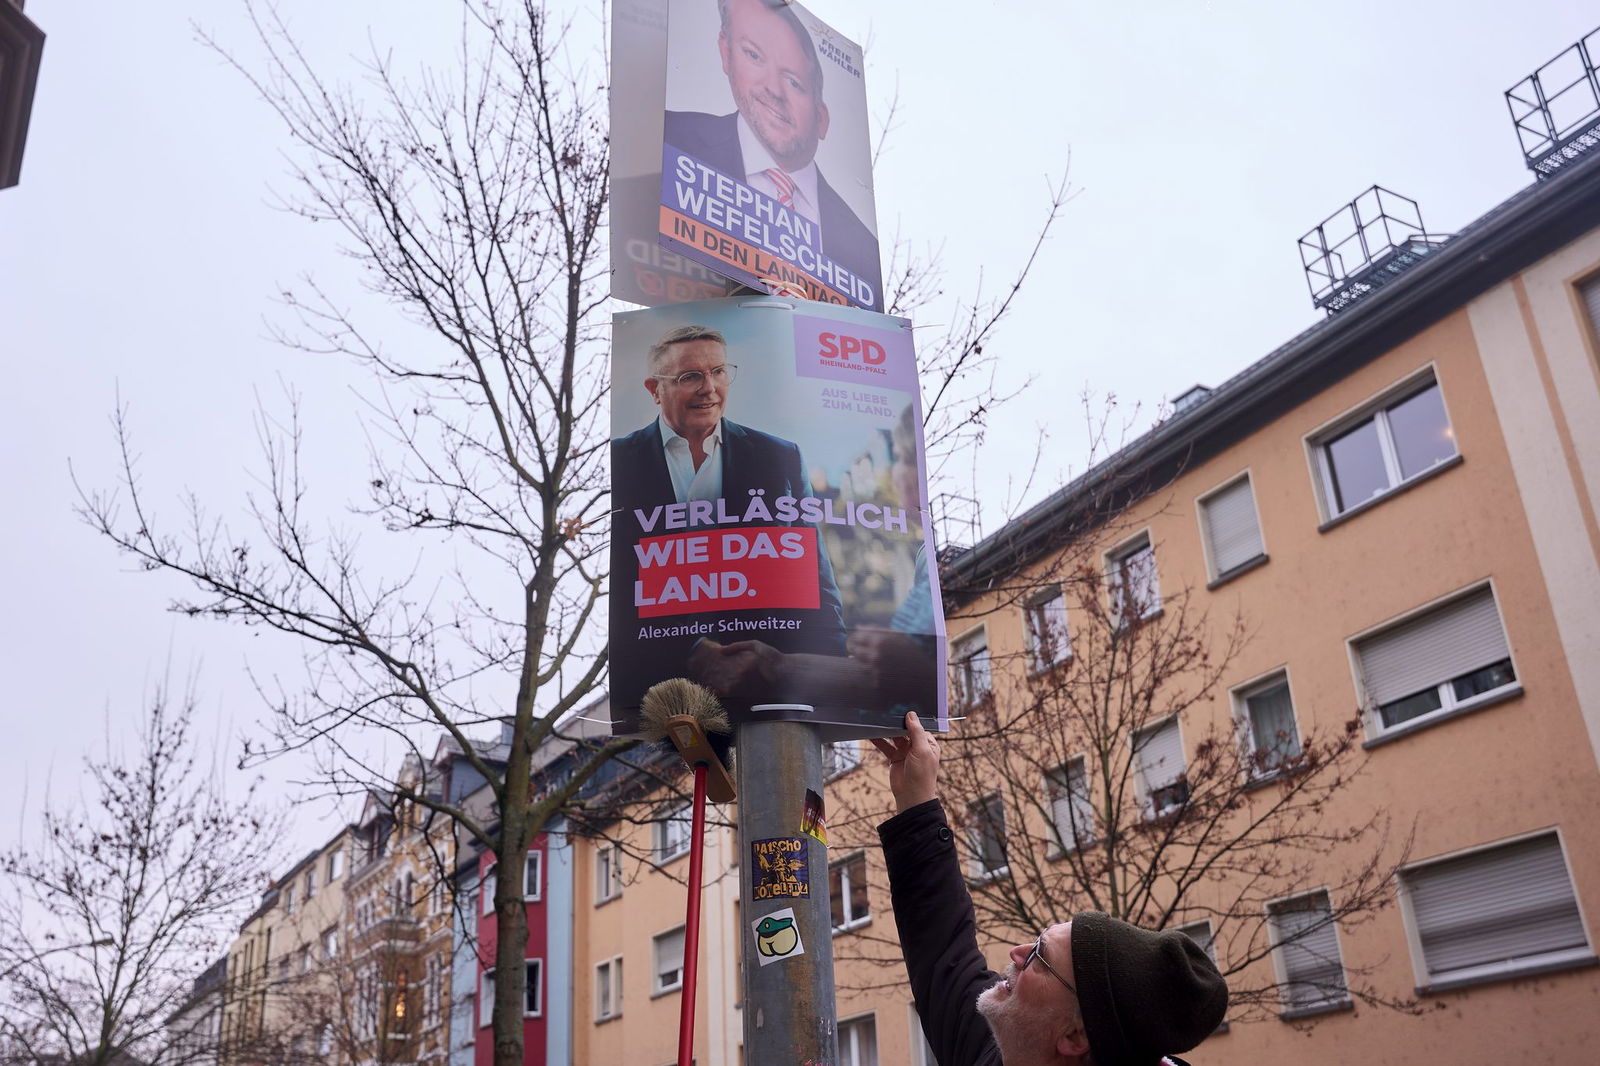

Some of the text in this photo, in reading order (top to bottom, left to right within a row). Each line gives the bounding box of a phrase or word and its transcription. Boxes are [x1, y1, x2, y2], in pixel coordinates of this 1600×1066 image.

[676, 155, 812, 245] STEPHAN
[674, 217, 696, 242] IN
[703, 231, 748, 266] DEN
[675, 181, 874, 306] WEFELSCHEID
[818, 332, 887, 365] SPD
[820, 359, 887, 375] RHEINLAND-PFALZ
[821, 387, 888, 405] AUS LIEBE
[822, 399, 896, 418] ZUM LAND.
[634, 488, 908, 534] VERLÄSSLICH
[633, 532, 805, 569] WIE DAS
[634, 571, 757, 606] LAND.
[638, 616, 802, 640] Alexander Schweitzer
